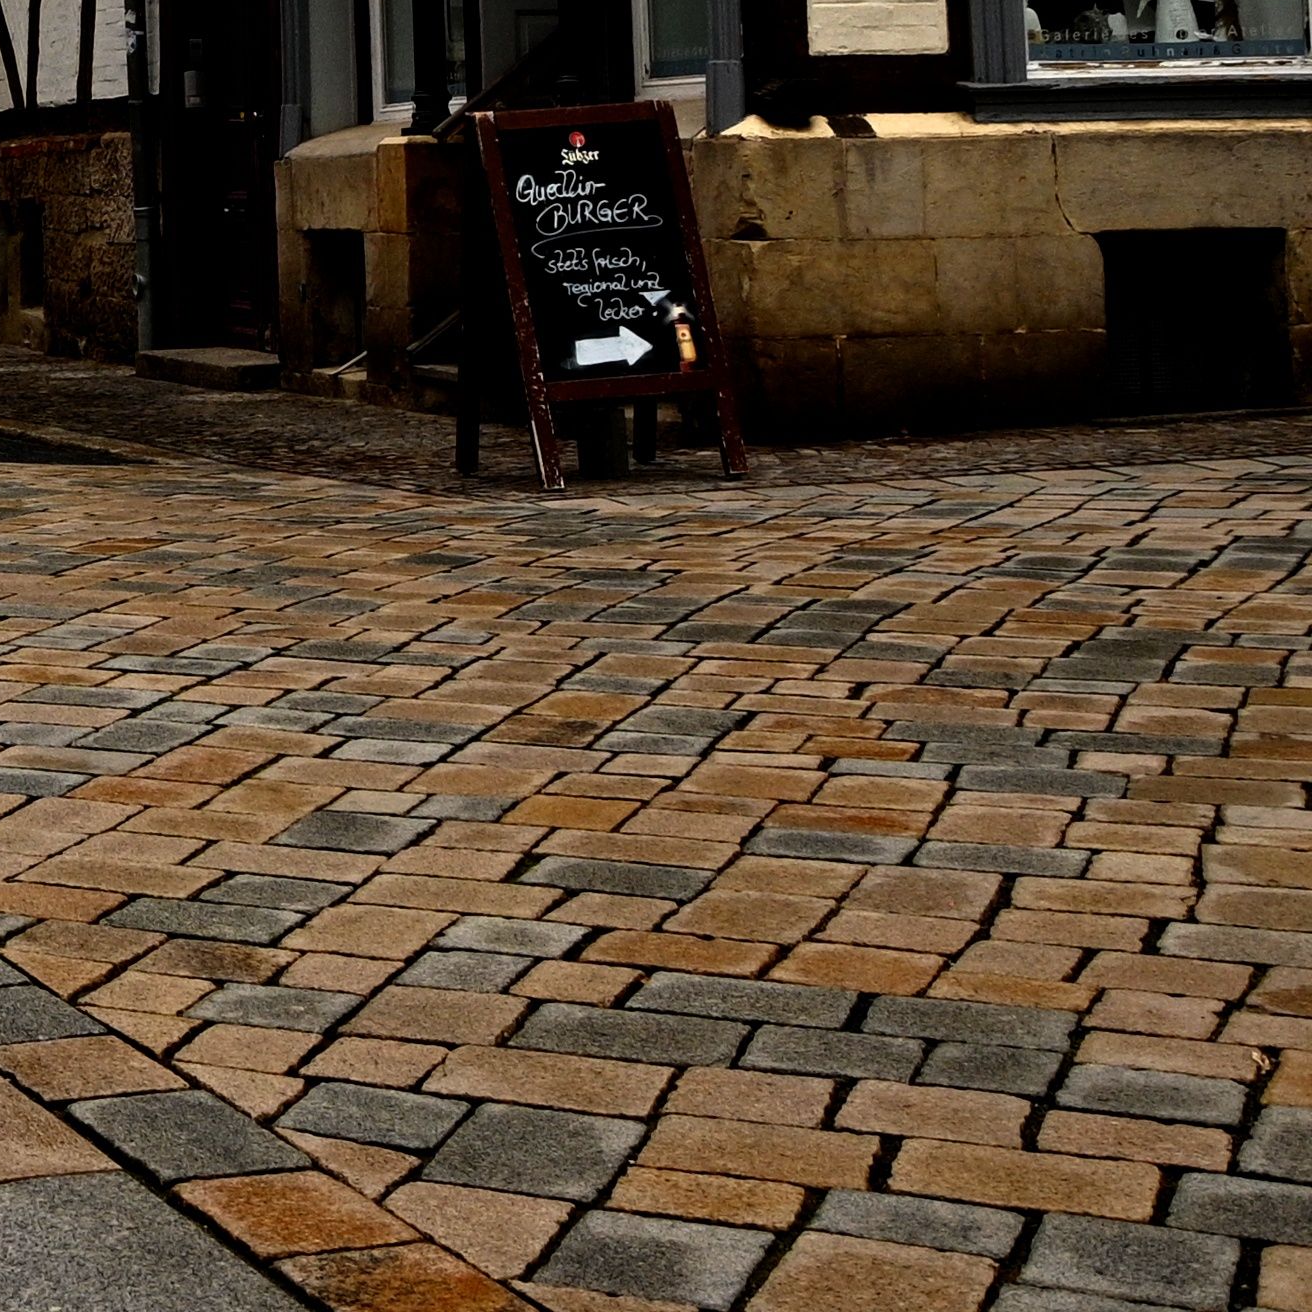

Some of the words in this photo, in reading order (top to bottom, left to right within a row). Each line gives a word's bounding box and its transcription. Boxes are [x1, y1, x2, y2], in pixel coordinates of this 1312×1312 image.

[1040, 28, 1111, 41] Galerie
[561, 148, 600, 165] Lübzer
[536, 194, 656, 235] BURGER
[545, 248, 589, 273] stets
[562, 273, 630, 303] regional
[631, 272, 664, 289] und
